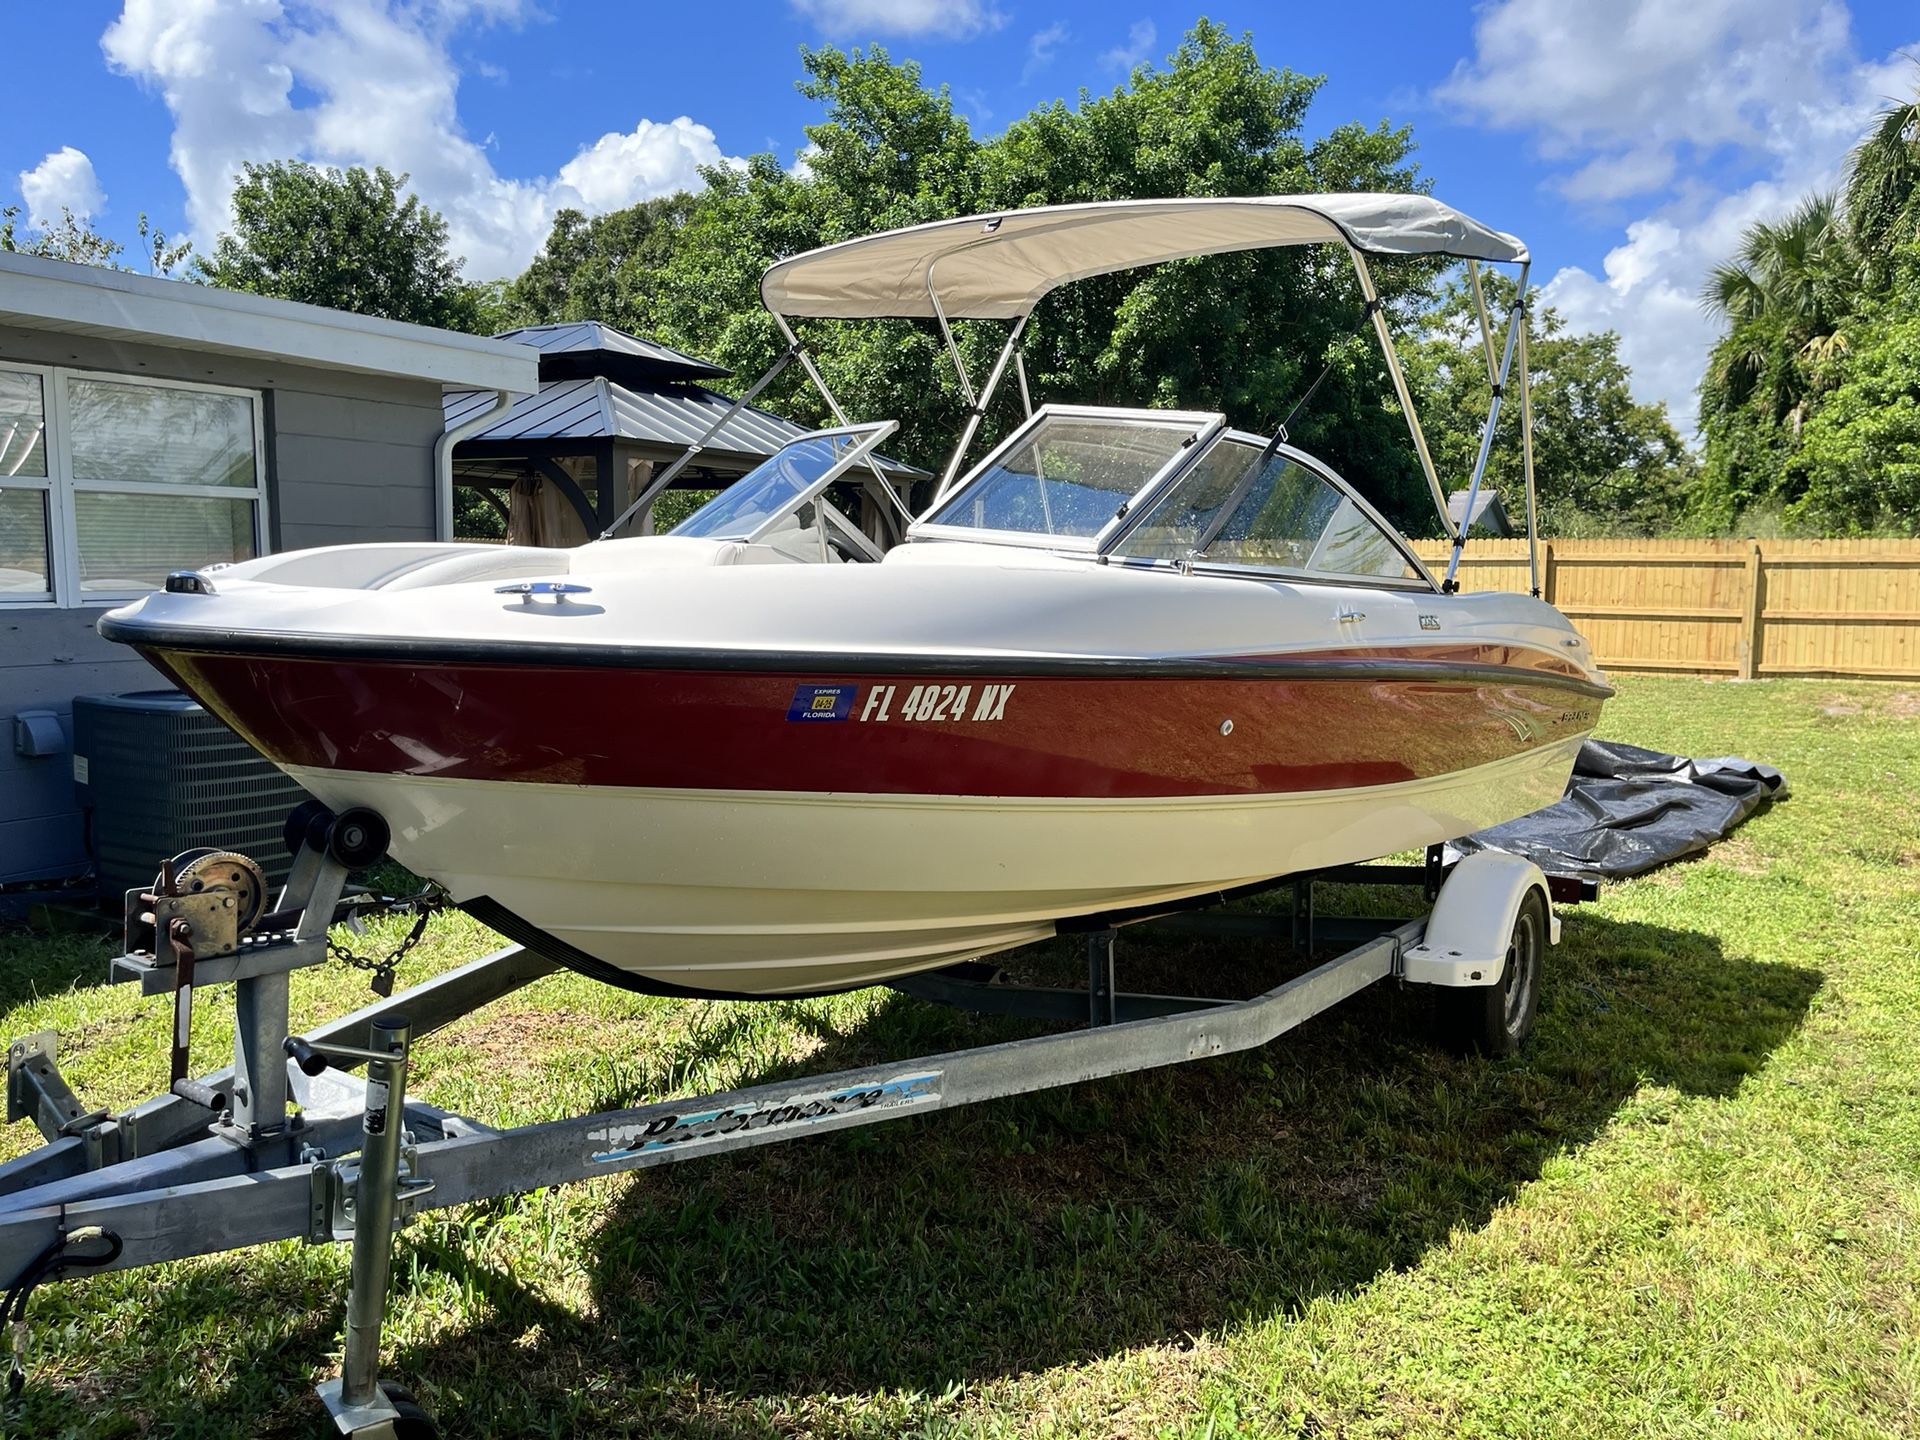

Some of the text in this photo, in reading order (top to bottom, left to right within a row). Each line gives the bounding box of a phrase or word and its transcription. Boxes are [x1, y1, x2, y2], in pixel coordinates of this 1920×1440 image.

[859, 684, 1017, 722] FL 4824 NX
[880, 1099, 915, 1110] TRAILERS
